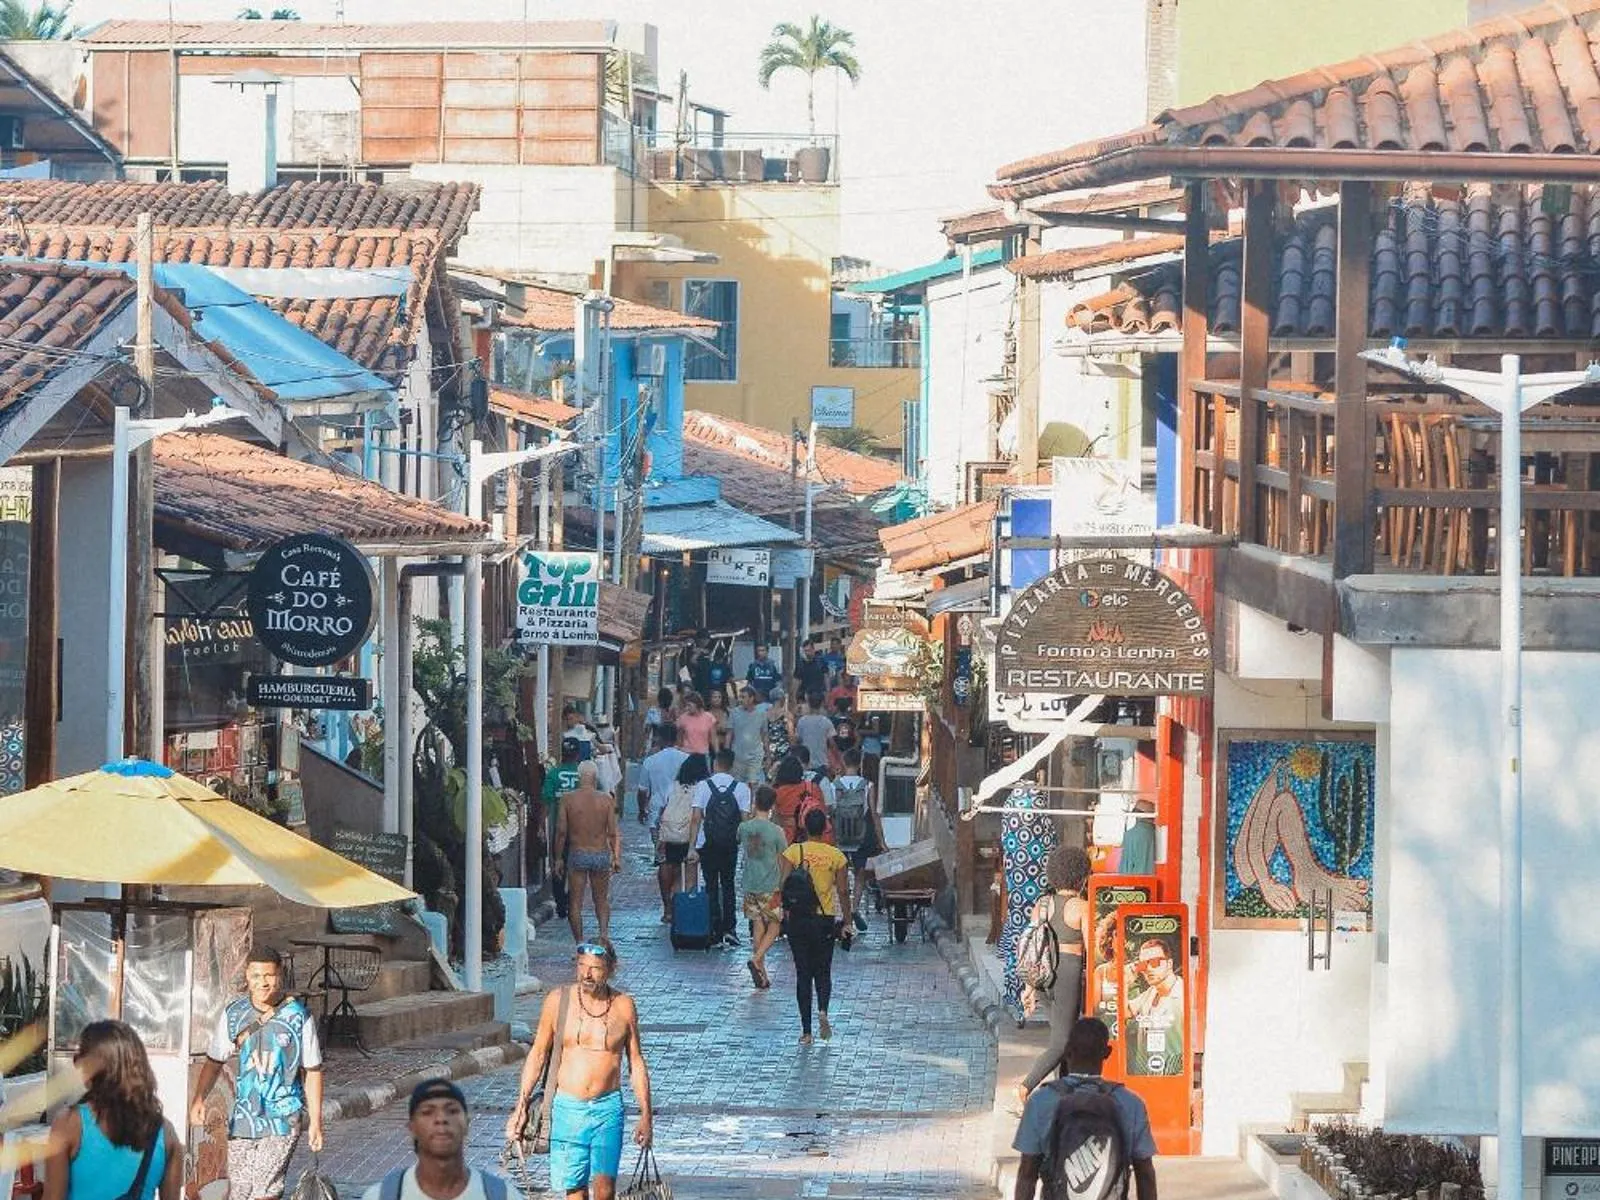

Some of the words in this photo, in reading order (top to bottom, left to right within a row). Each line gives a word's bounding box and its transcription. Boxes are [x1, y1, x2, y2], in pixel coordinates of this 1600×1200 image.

[292, 591, 327, 608] DO
[518, 578, 598, 607] Grill
[519, 606, 597, 618] Restaurante
[1000, 564, 1089, 656] PIZZARIA
[1100, 564, 1114, 574] DE
[1123, 563, 1209, 658] MERCEDES
[526, 617, 535, 626] &
[539, 618, 588, 628] Pizzaria
[562, 630, 597, 640] Lenha
[1037, 645, 1096, 659] Forno
[1118, 646, 1176, 659] Lenha
[1007, 669, 1205, 691] RESTAURANTE
[258, 682, 357, 697] HAMBURGUERIA
[282, 694, 332, 704] GOURMET
[1064, 1135, 1103, 1190] NIKE
[1552, 1146, 1600, 1166] PINEAP
